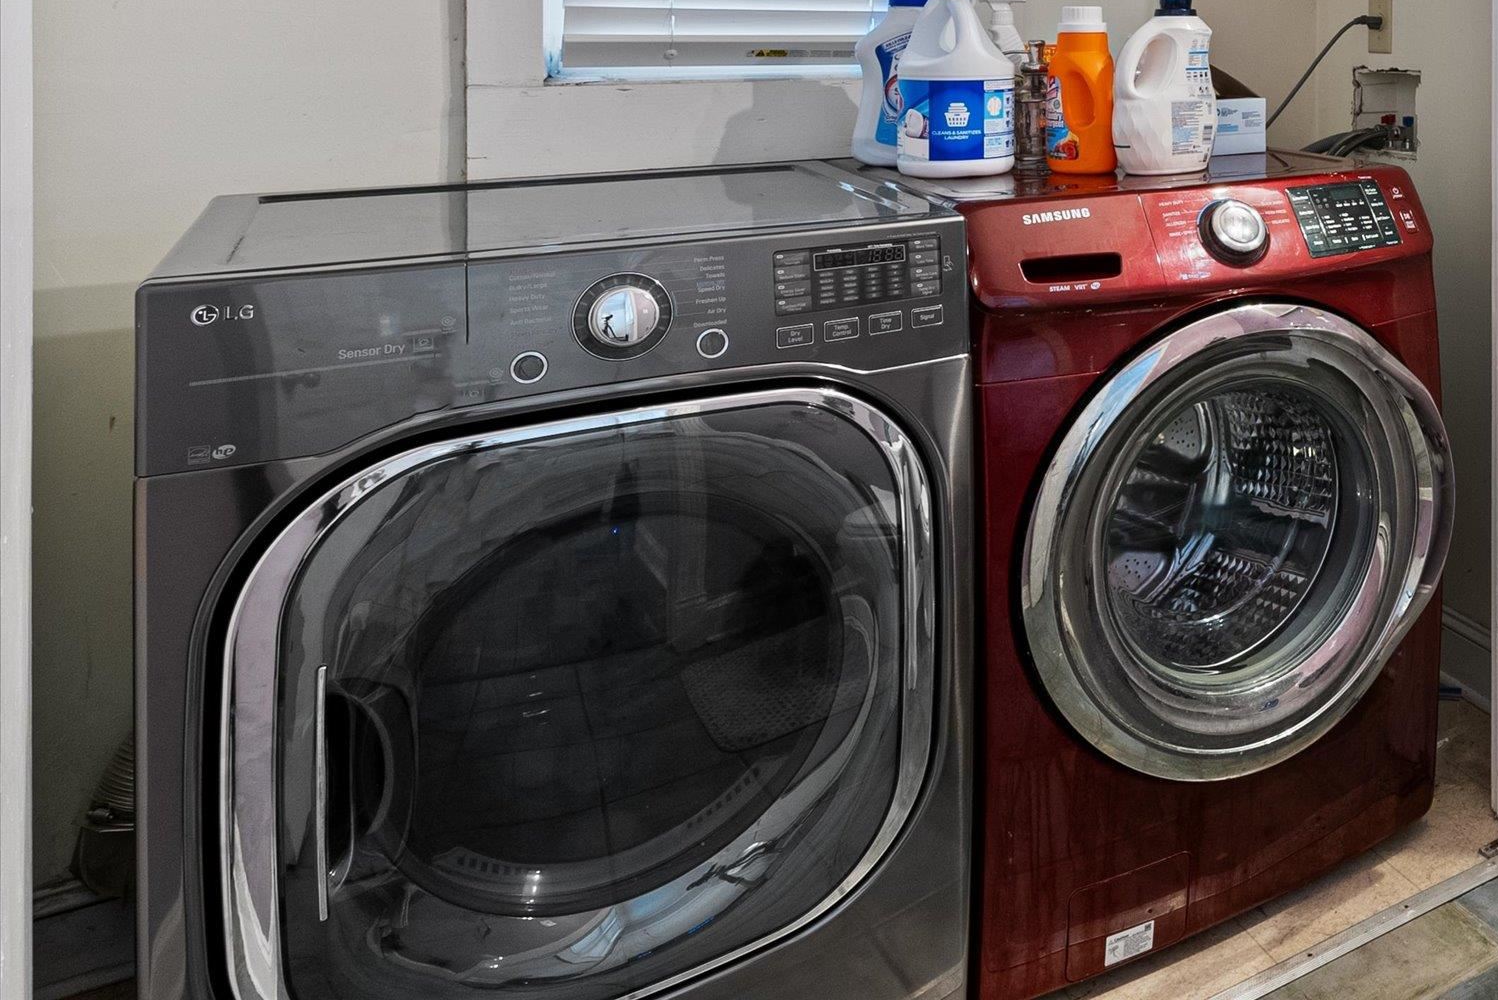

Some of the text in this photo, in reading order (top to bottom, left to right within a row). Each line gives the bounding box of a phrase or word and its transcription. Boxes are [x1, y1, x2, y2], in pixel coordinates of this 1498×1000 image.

[1022, 207, 1091, 225] SAMSUNG
[338, 344, 406, 360] Sensor Dry
